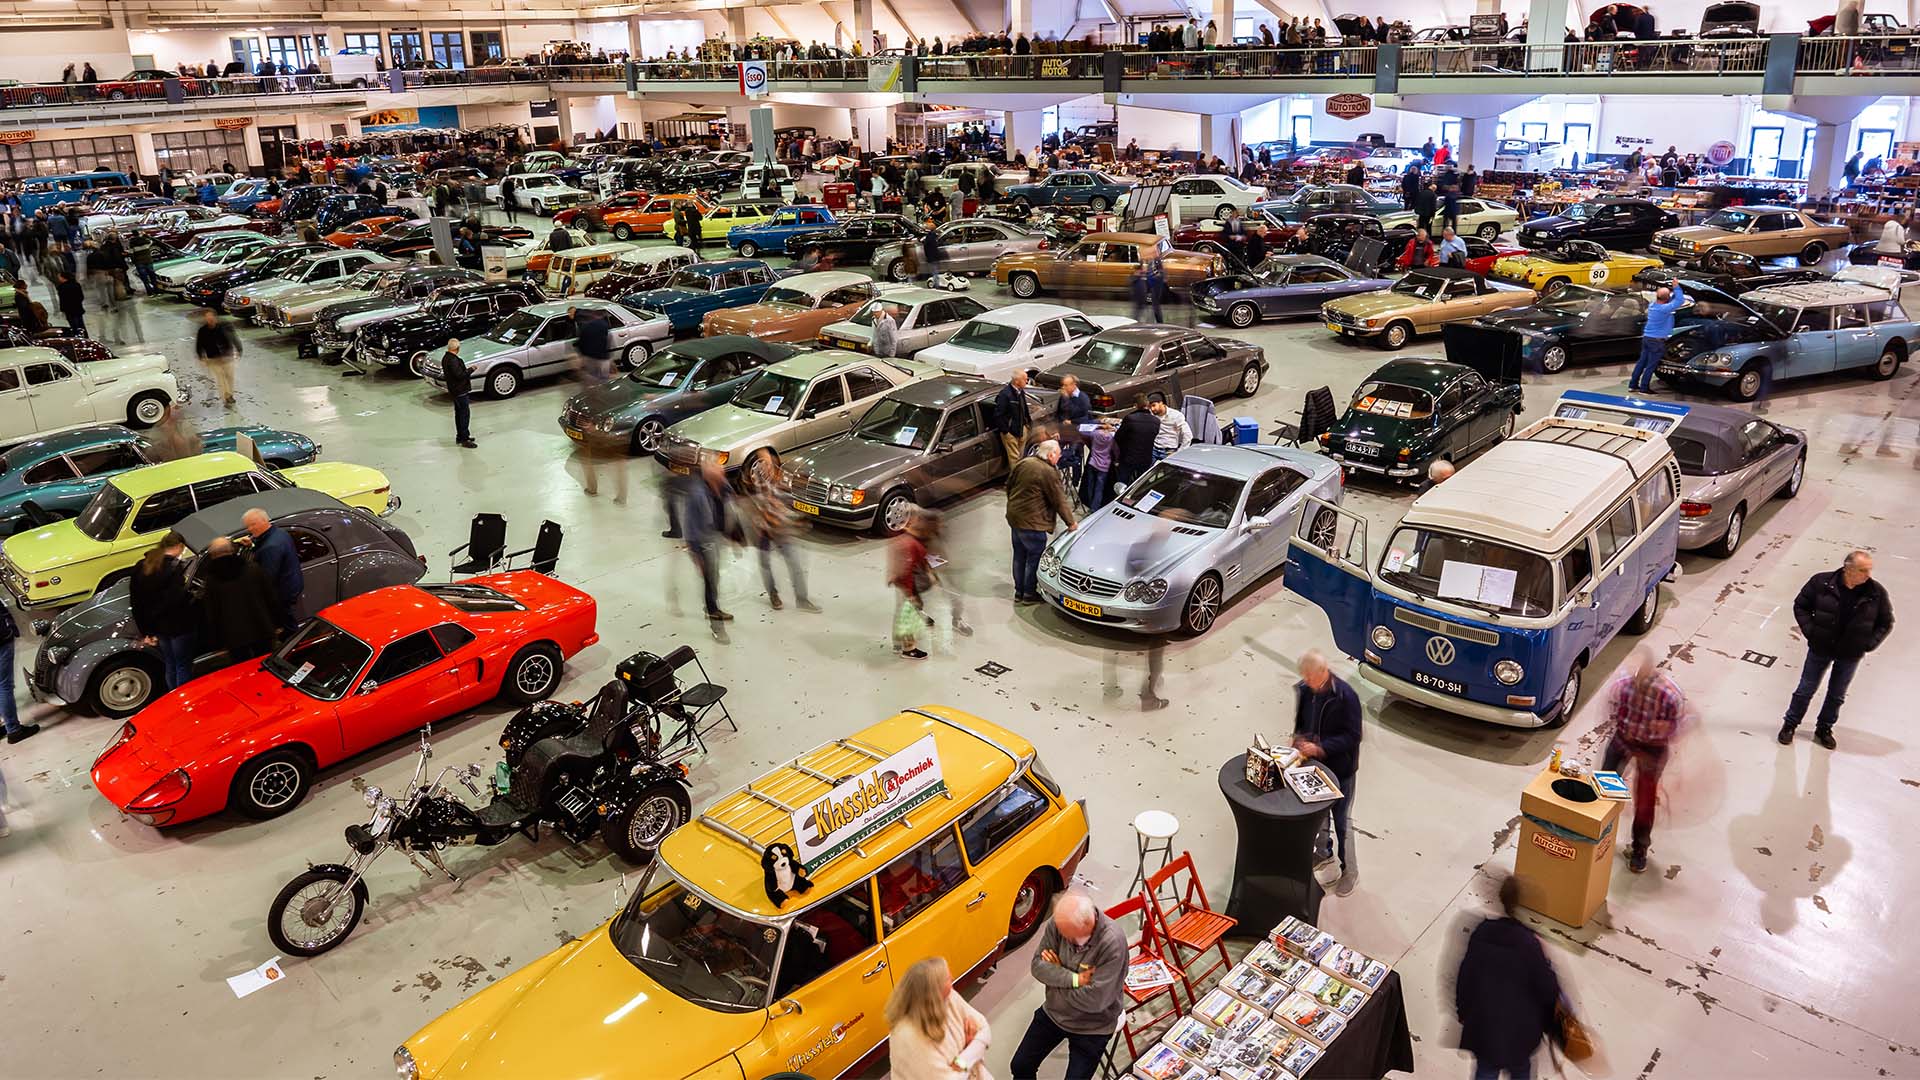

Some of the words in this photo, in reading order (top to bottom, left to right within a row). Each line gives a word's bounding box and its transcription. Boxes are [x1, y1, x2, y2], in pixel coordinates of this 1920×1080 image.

[1042, 58, 1062, 67] AUTO
[1041, 67, 1069, 76] MOTOR
[1328, 101, 1369, 111] AUTOTRON
[217, 117, 250, 125] AUTOTRON
[1592, 270, 1606, 279] 80
[1064, 598, 1100, 615] 93-NH-RD
[1415, 672, 1462, 694] 88-70-SH
[811, 770, 889, 839] Klassiek
[1534, 835, 1574, 857] AUTOTRON
